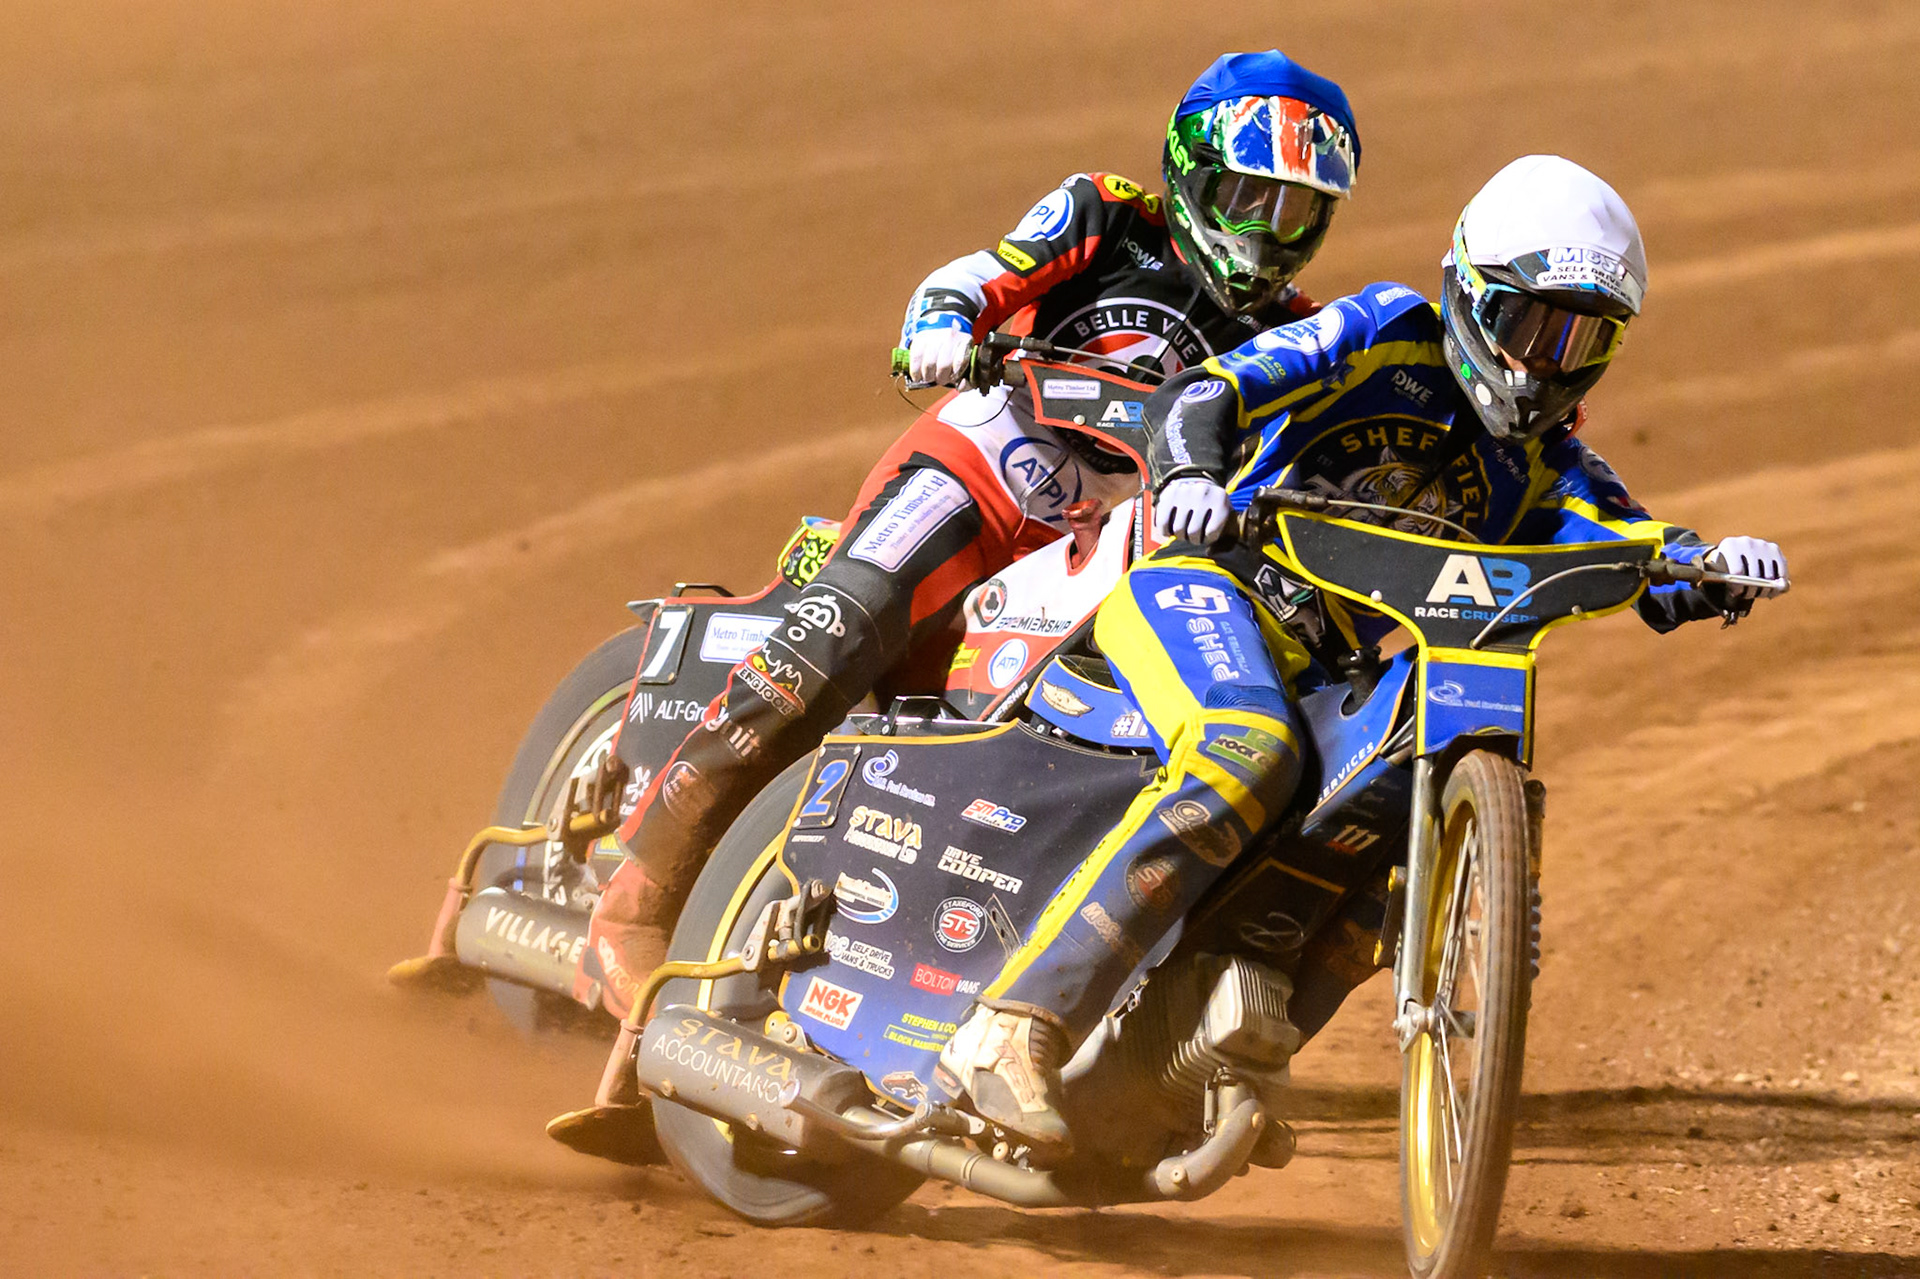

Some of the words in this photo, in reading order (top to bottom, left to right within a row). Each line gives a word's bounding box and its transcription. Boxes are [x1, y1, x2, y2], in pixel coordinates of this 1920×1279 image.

[1543, 274, 1576, 282] VANS
[1074, 309, 1149, 338] BELLE
[1162, 318, 1199, 360] VUE
[1341, 426, 1481, 542] SHEFFIEL
[863, 522, 899, 554] Metro
[890, 489, 931, 520] Timber
[1425, 554, 1533, 609] AB
[1415, 607, 1459, 619] RACE
[1461, 609, 1539, 625] CRUSERS
[643, 611, 688, 678] 7
[711, 626, 738, 640] Metro
[996, 657, 1020, 671] ATPI
[800, 759, 850, 817] 2
[849, 806, 922, 850] STAVA
[944, 845, 983, 865] DAVE
[937, 855, 1023, 894] COOPER
[484, 906, 588, 965] VILLAGE
[940, 912, 978, 935] STS
[840, 952, 859, 966] VANS
[866, 961, 893, 977] TRUCKS
[851, 943, 869, 957] SELF
[869, 949, 891, 963] DRIVE
[914, 968, 956, 992] BOLTON
[955, 979, 981, 994] VANS
[809, 982, 857, 1018] NGK
[823, 1012, 846, 1027] PLUGS
[901, 1013, 939, 1031] STEPHEN
[944, 1022, 958, 1034] CO
